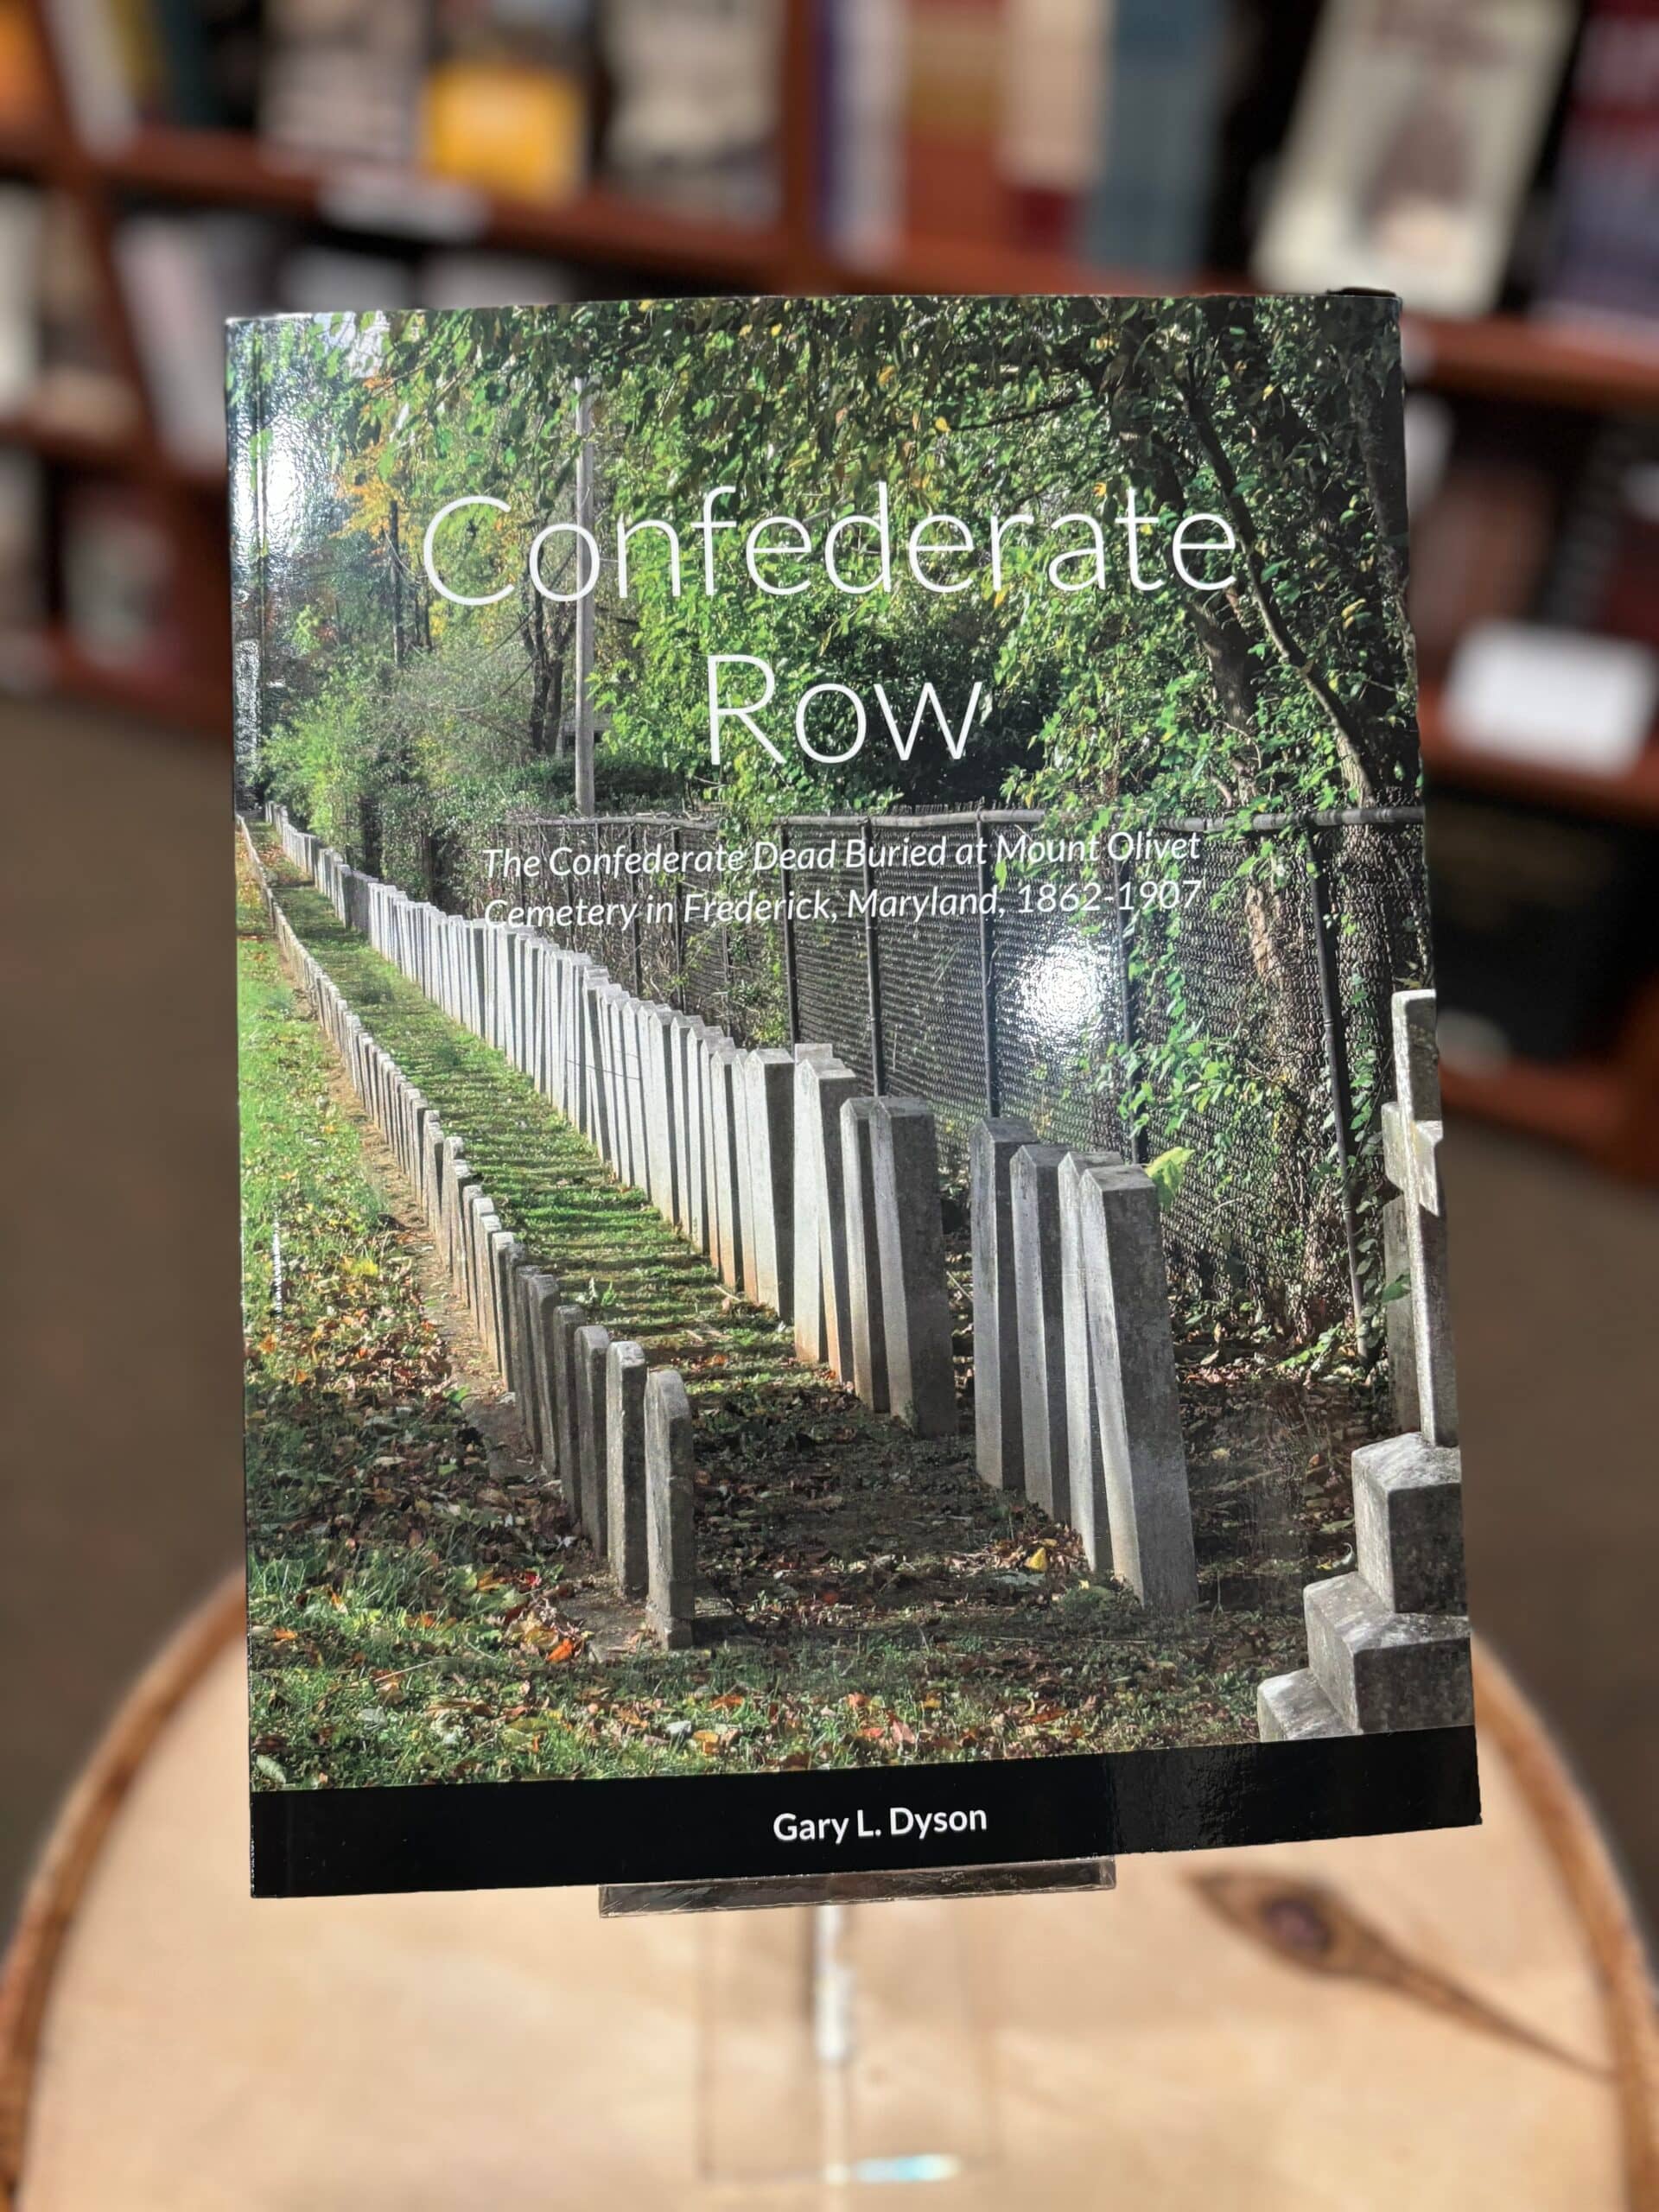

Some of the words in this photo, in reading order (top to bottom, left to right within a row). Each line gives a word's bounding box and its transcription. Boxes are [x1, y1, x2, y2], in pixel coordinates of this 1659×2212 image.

[423, 481, 1237, 606] Confederate
[707, 654, 982, 766] Row
[481, 848, 540, 878] The
[549, 842, 744, 880] Confederate
[753, 839, 837, 872] Dead
[845, 836, 946, 868] Buried
[955, 842, 988, 865] at
[995, 834, 1100, 864] Mount
[1107, 831, 1201, 862] Olivet
[484, 899, 638, 931] Cemetery
[646, 895, 674, 924] in
[683, 889, 838, 925] Frederick,
[848, 886, 1006, 923] Maryland,
[1018, 880, 1202, 913] 1862-1907
[773, 1813, 849, 1845] Gary
[857, 1809, 881, 1837] L.
[890, 1807, 988, 1840] Dyson
